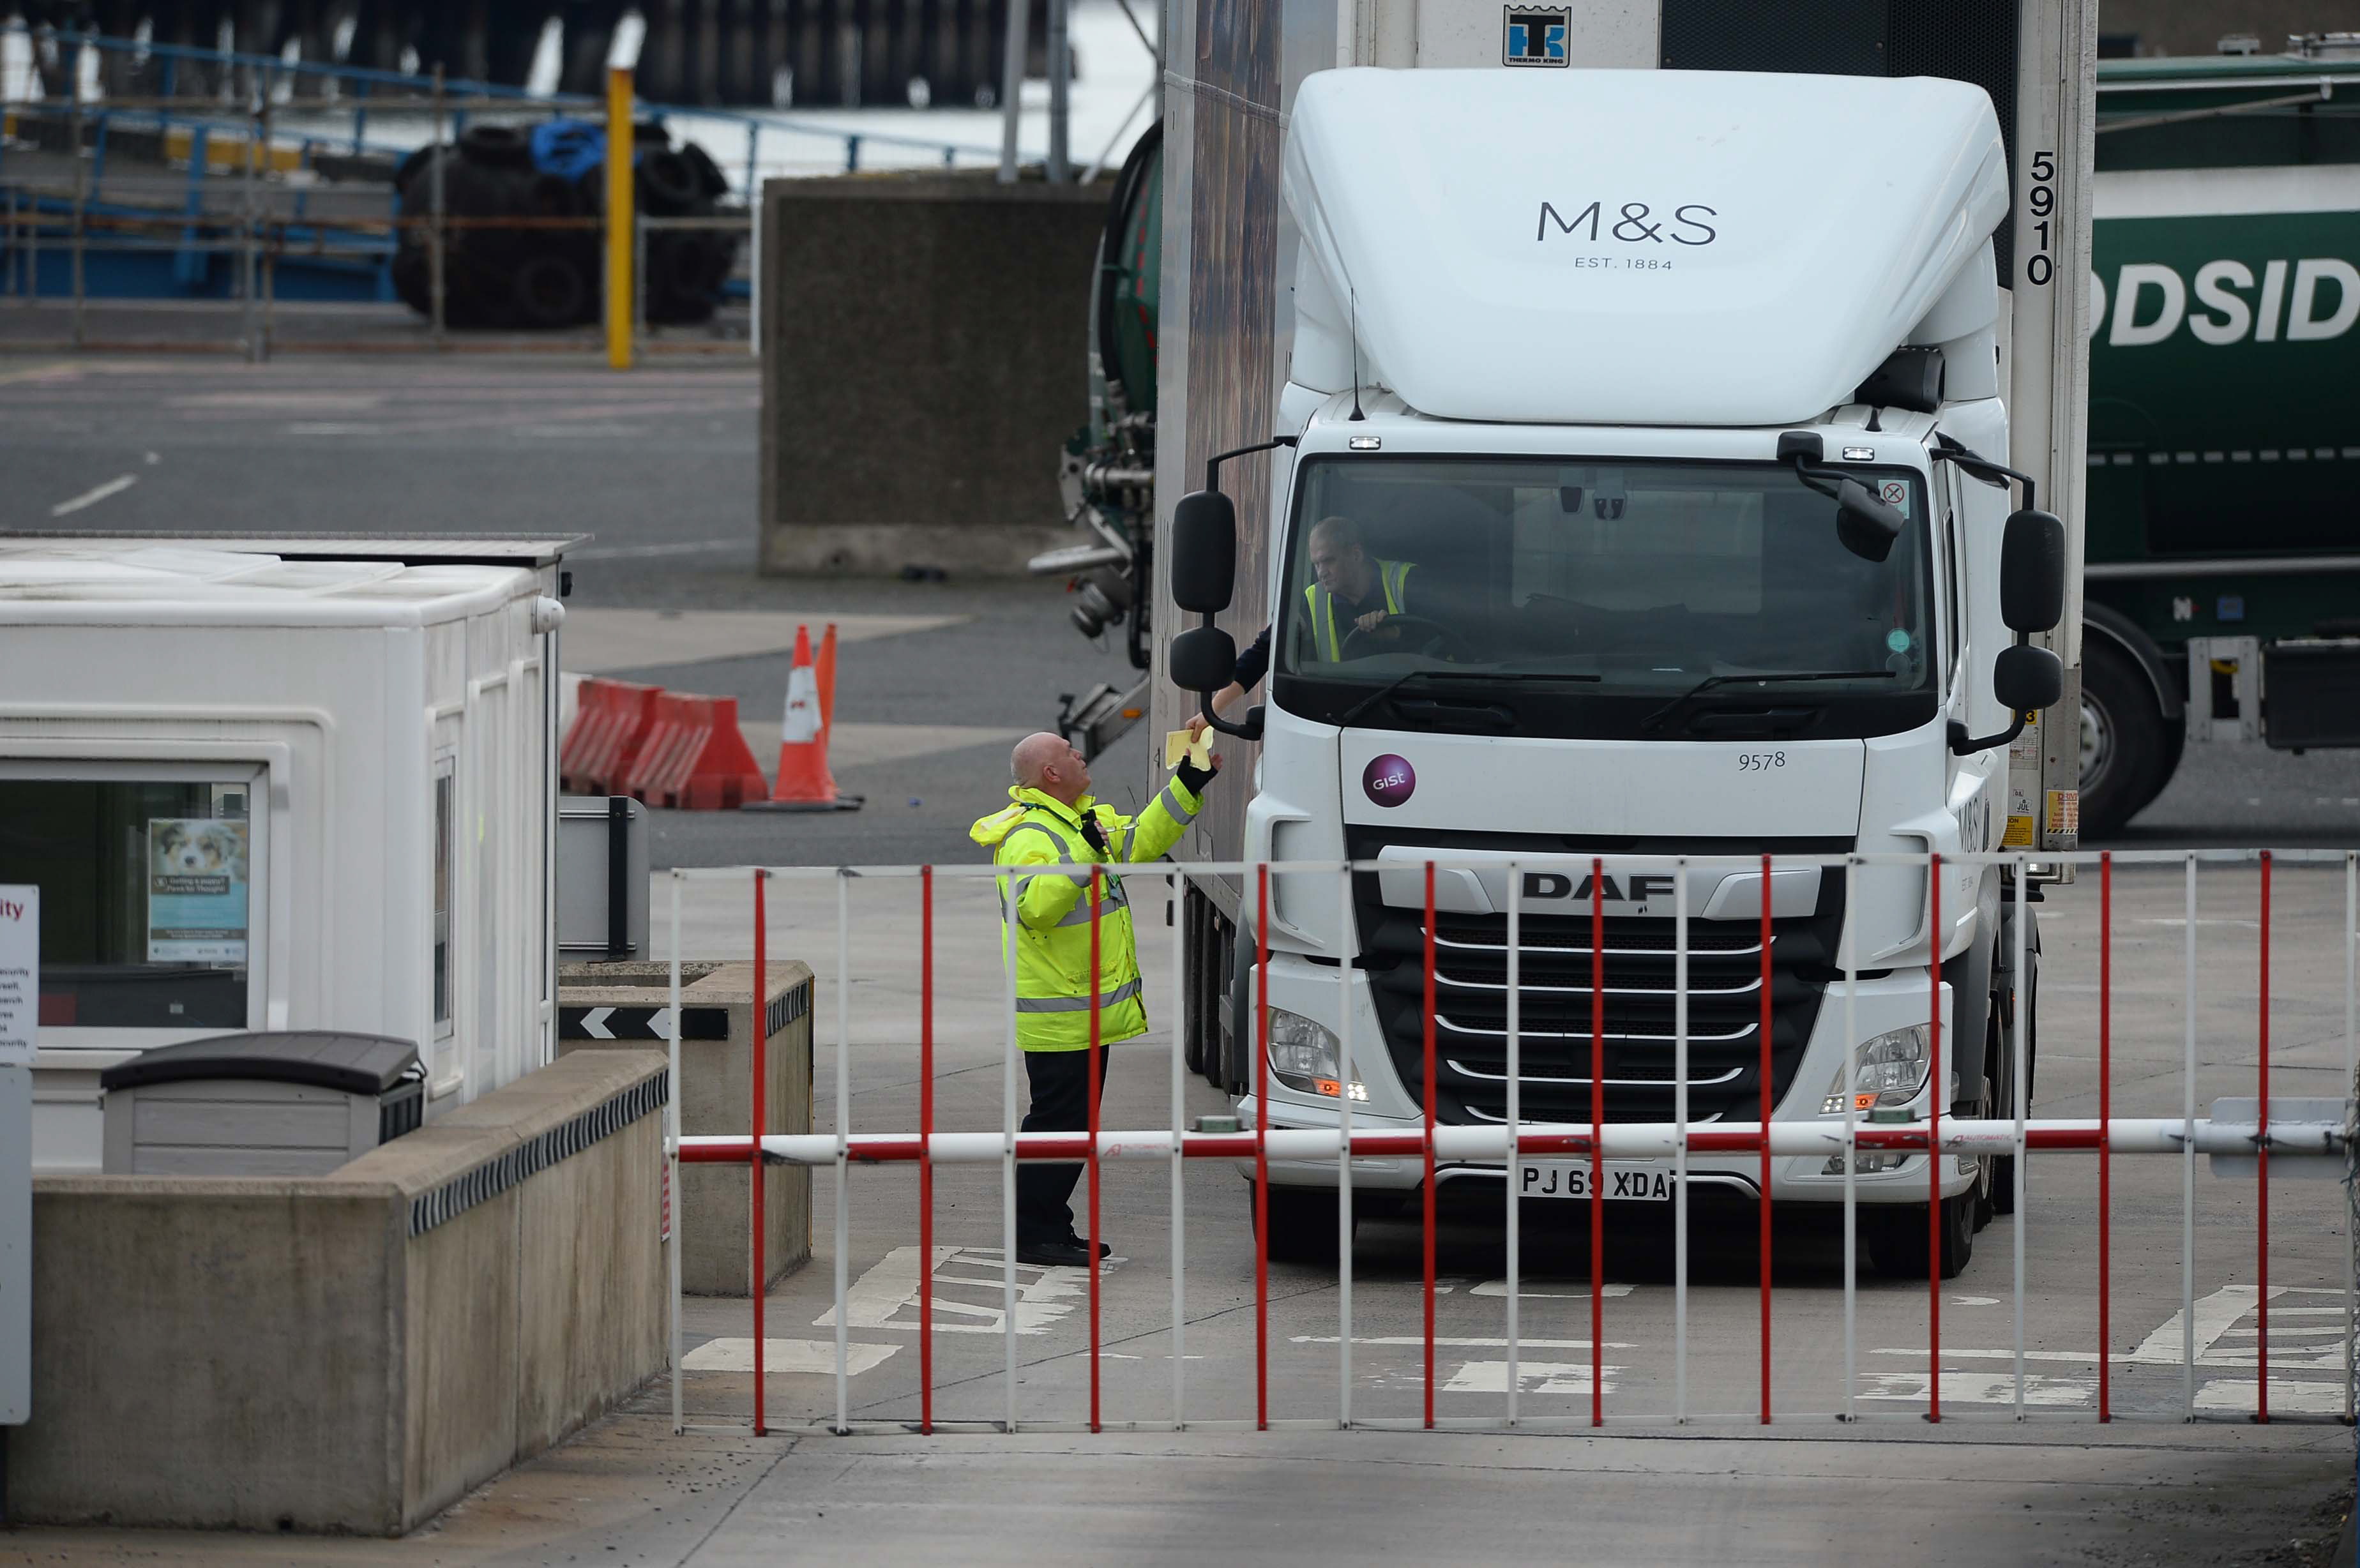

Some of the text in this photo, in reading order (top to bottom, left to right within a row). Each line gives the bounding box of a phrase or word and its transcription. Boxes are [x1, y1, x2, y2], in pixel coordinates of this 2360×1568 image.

[1537, 201, 1718, 246] M&S
[2027, 151, 2055, 287] 5910
[1575, 257, 1673, 270] EST. 1884
[2089, 257, 2360, 347] DSID
[1739, 751, 1786, 771] 9578
[2017, 803, 2030, 811] JUL
[1522, 870, 1675, 902] DAF
[1523, 1167, 1557, 1195] PJ
[1614, 1172, 1667, 1198] XDA
